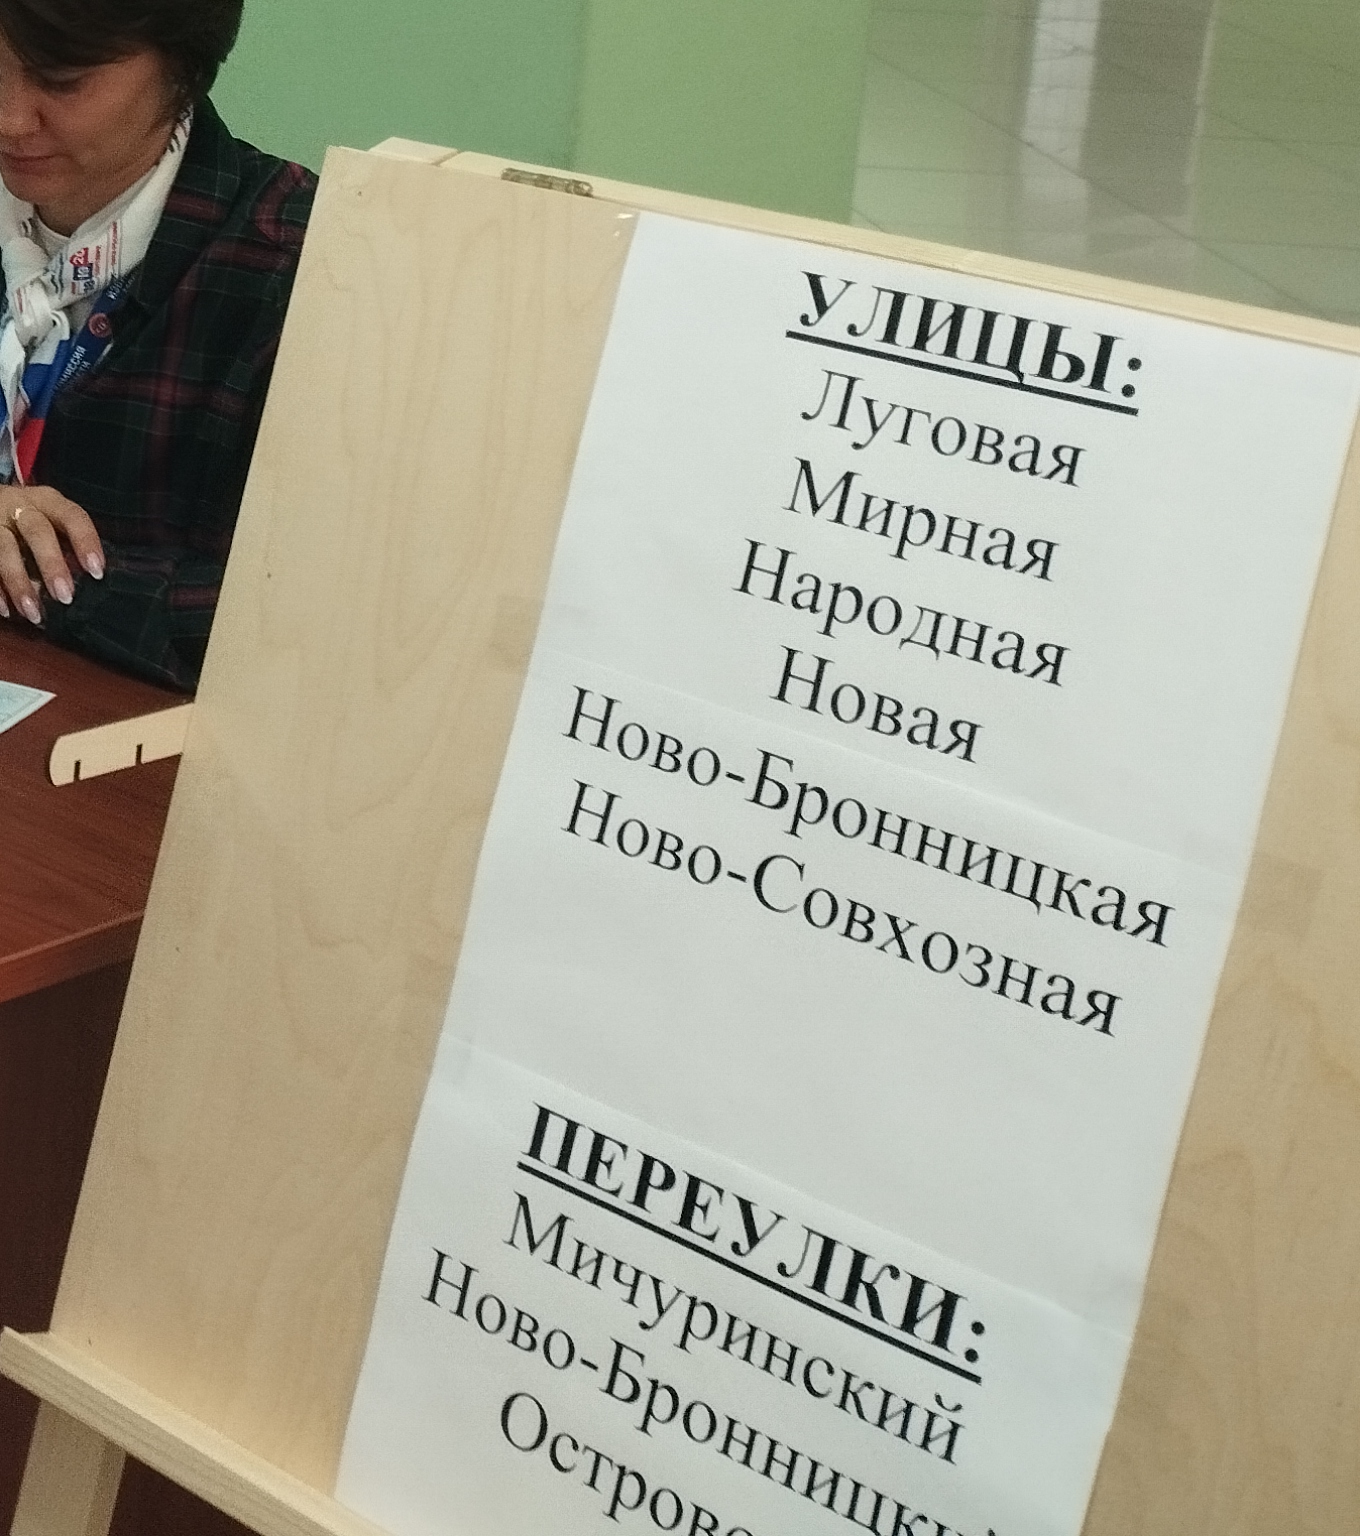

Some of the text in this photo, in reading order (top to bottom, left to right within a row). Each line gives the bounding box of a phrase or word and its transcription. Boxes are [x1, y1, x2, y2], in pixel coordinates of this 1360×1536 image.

[799, 270, 1144, 400] УЛИЦЫ:
[801, 369, 1084, 488] Луговая
[782, 456, 1060, 582] Мирная
[732, 537, 1071, 687] Народная
[769, 644, 985, 764] Новая
[561, 685, 1176, 948] Ново-Бронницкая
[560, 779, 1122, 1038] Ново-Совхозная
[522, 1102, 987, 1366] ПЕРЕУЛКИ:
[502, 1190, 966, 1466] Мичуринский
[499, 1391, 755, 1536] Остров
